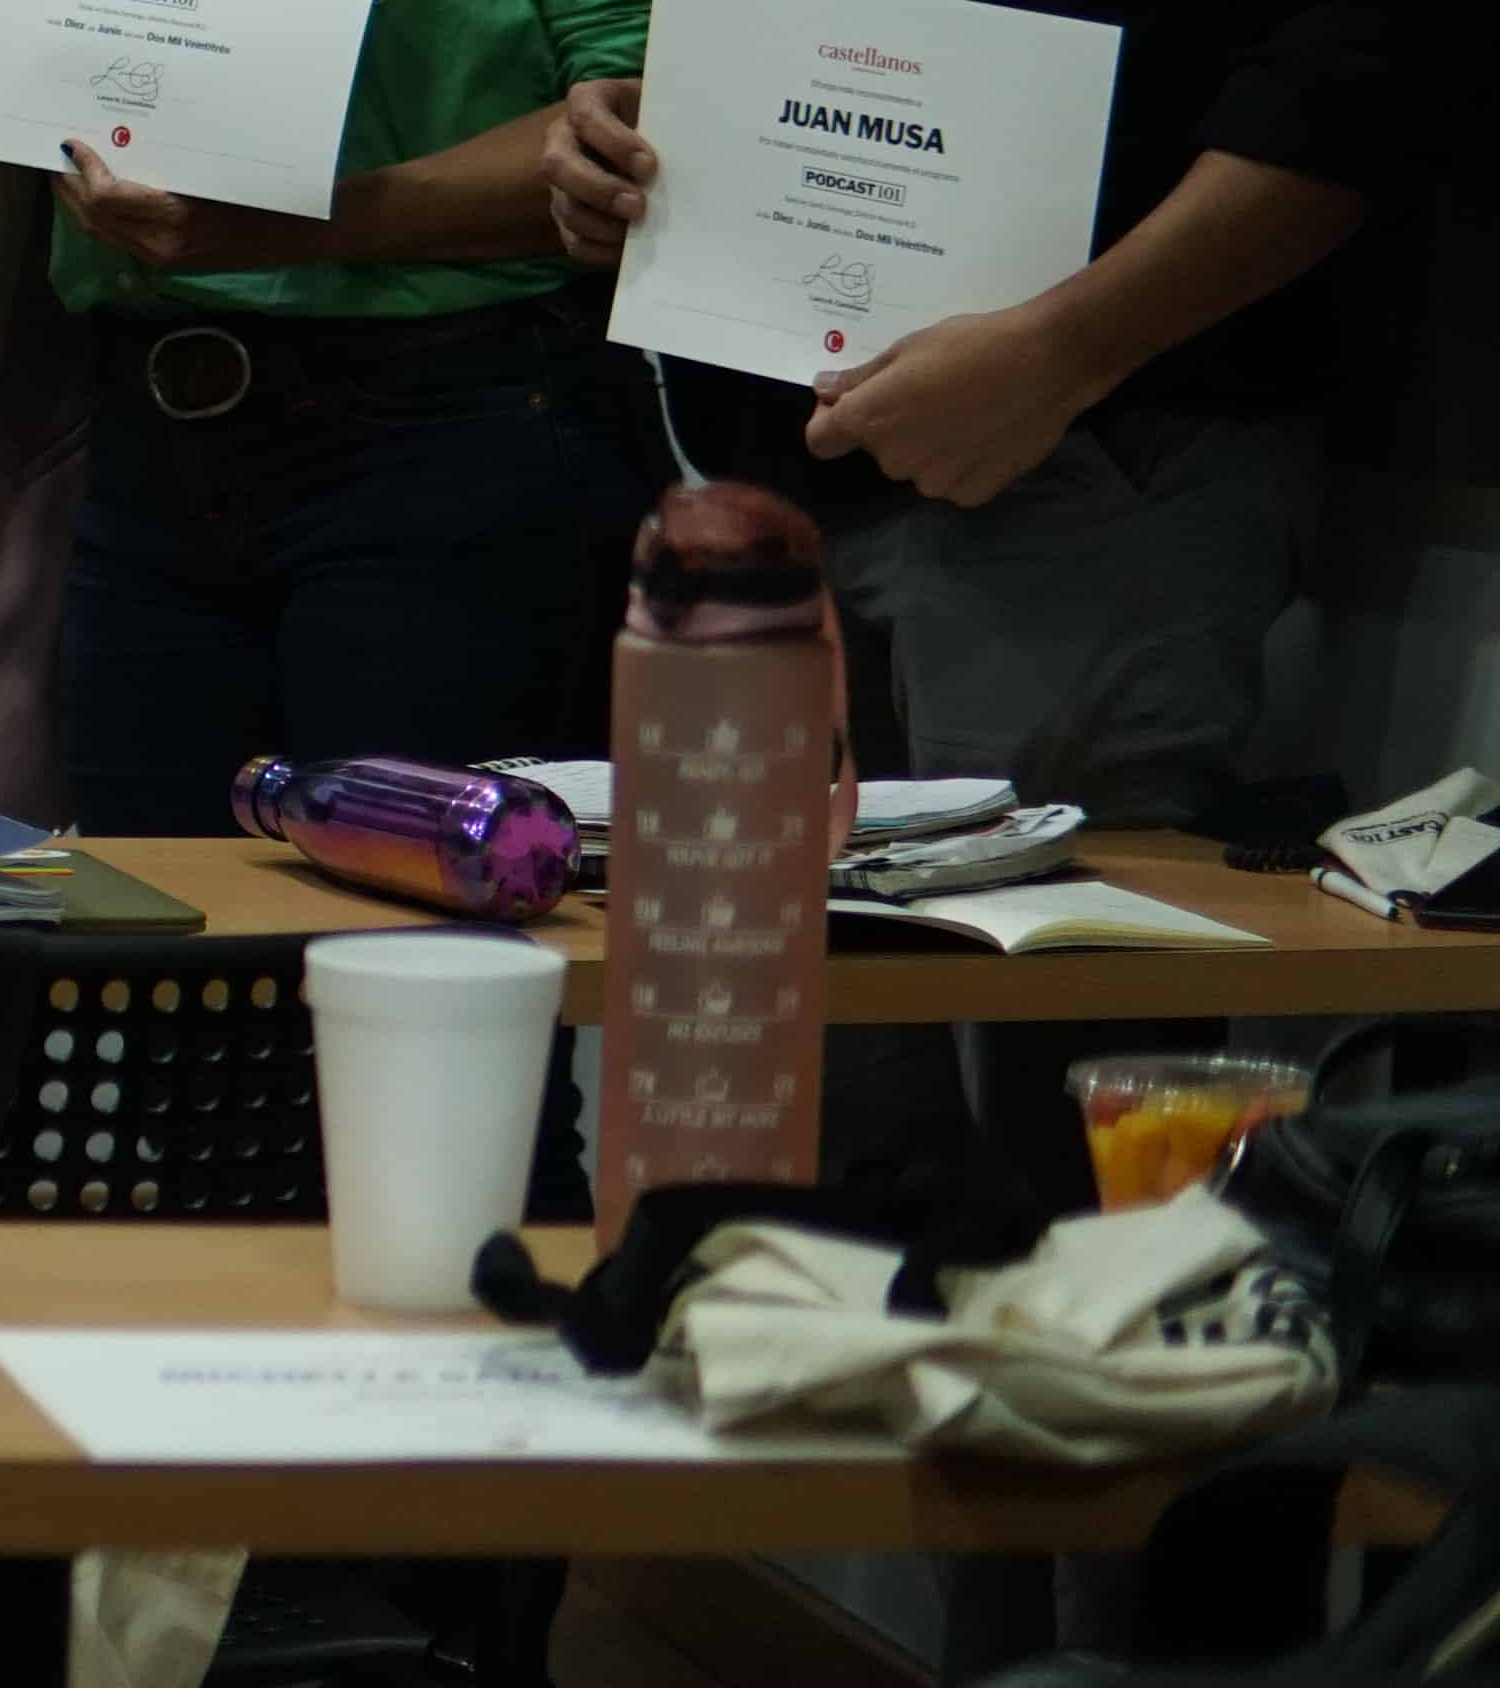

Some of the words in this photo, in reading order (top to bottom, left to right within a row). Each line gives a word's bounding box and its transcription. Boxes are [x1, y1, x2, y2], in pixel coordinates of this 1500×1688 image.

[818, 44, 922, 75] castellanos
[778, 99, 853, 136] JUAN
[857, 113, 945, 154] MUSA
[805, 170, 876, 196] PODCAST
[877, 184, 901, 202] 101
